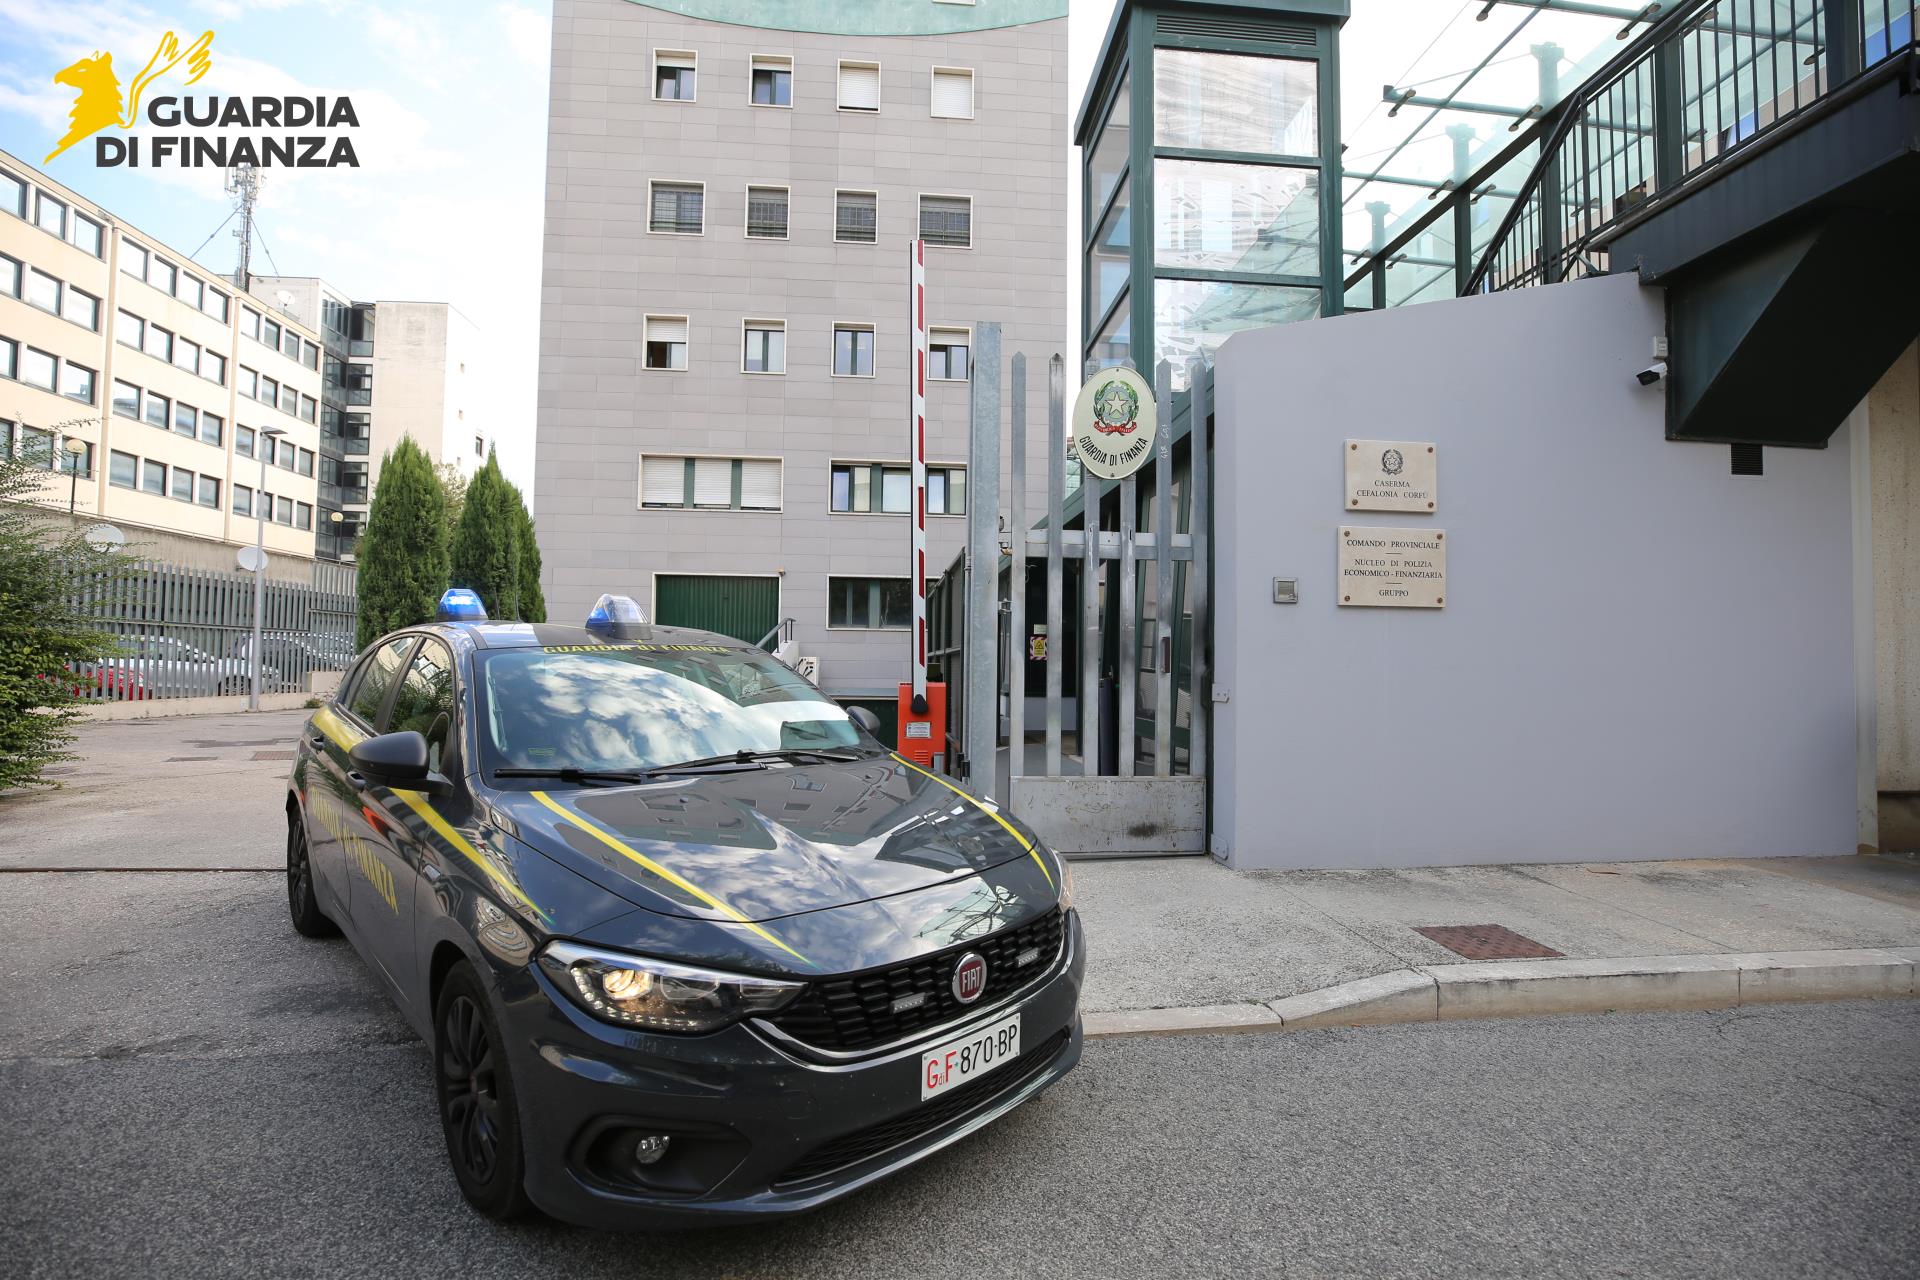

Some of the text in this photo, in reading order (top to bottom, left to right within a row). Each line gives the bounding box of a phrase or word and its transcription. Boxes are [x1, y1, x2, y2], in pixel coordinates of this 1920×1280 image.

[1080, 435, 1108, 465] GUARDIA
[1109, 454, 1118, 466] DI
[1120, 437, 1148, 464] FINANZA
[1374, 479, 1411, 488] CASERMA
[1356, 489, 1399, 499] CEFALONIA
[1346, 539, 1440, 550] COMANDO PROVINCIALE
[1354, 558, 1433, 568] NUCLEO DI POLIZIA
[1378, 589, 1409, 597] GRUPPO
[543, 645, 632, 654] GUARDIA
[961, 966, 982, 993] FIAT
